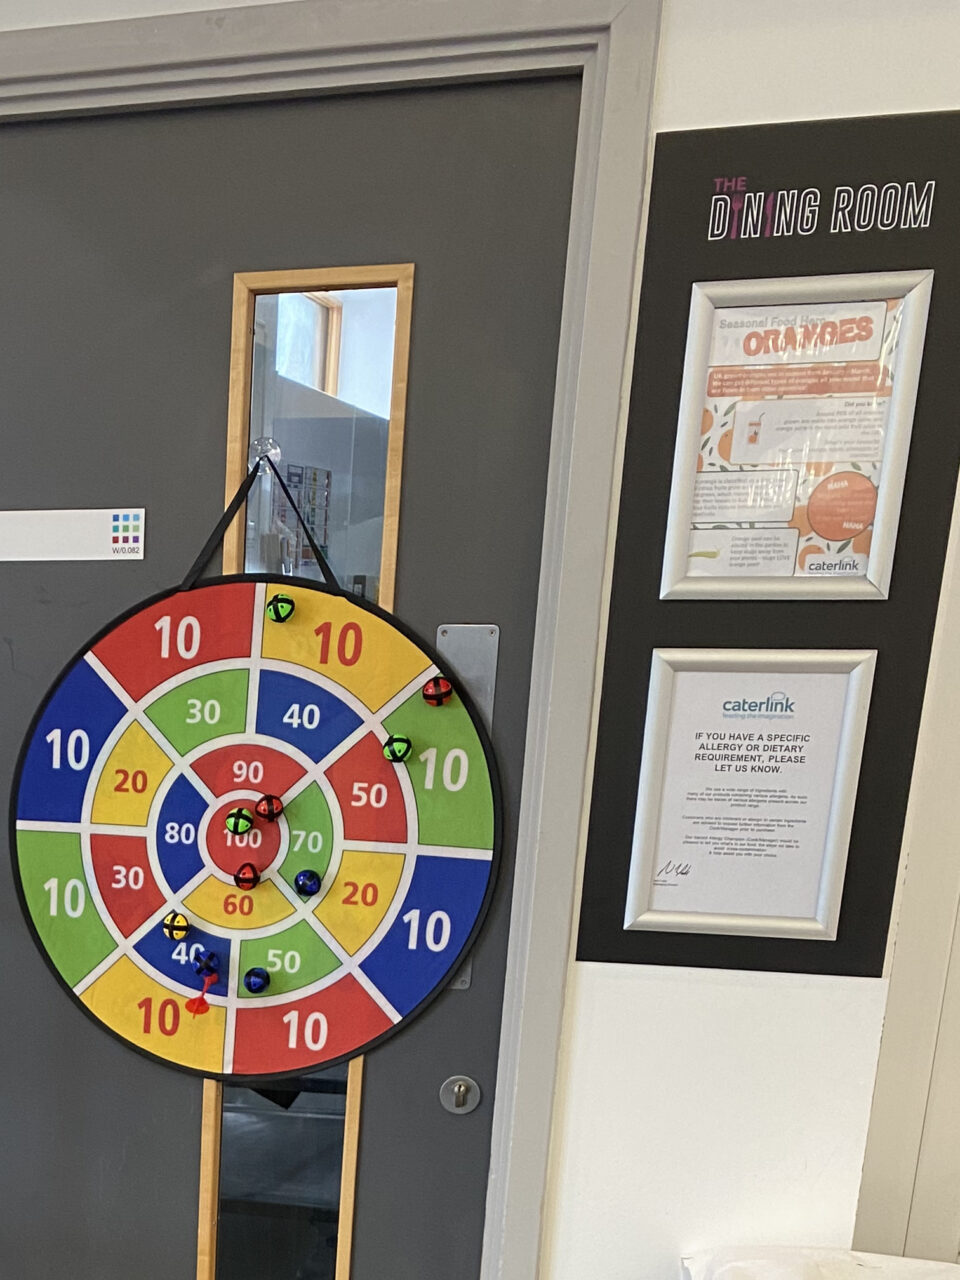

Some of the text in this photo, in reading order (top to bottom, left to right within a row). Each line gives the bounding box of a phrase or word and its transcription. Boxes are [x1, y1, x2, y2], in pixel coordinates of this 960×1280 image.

[714, 177, 747, 192] THE
[830, 181, 936, 233] ROOM
[719, 317, 768, 330] Seasonal
[771, 316, 797, 328] Food
[743, 316, 874, 356] ORANGES
[808, 560, 859, 571] caterlink
[154, 615, 202, 660] 10
[313, 621, 364, 667] 10
[185, 699, 222, 725] 30
[282, 703, 321, 729] 40
[723, 697, 795, 712] caterlink
[695, 732, 704, 740] IF
[728, 733, 755, 741] HAVE
[767, 734, 811, 742] SPECIFIC
[698, 743, 804, 753] ALLERGY OR DIETARY
[45, 728, 91, 772] 10
[694, 753, 806, 763] REQUIREMENT, PLEASE
[232, 760, 264, 784] 90
[418, 747, 470, 792] 10
[714, 764, 783, 773] LET US KNOW.
[113, 769, 149, 794] 20
[350, 782, 389, 809] 50
[164, 822, 196, 845] 80
[223, 829, 262, 848] 100
[292, 830, 324, 854] 70
[111, 865, 145, 890] 30
[43, 877, 86, 918] 10
[222, 893, 254, 916] 60
[342, 881, 379, 907] 20
[402, 908, 452, 952] 10
[267, 949, 302, 974] 50
[137, 996, 180, 1037] 10
[282, 1009, 329, 1052] 10
